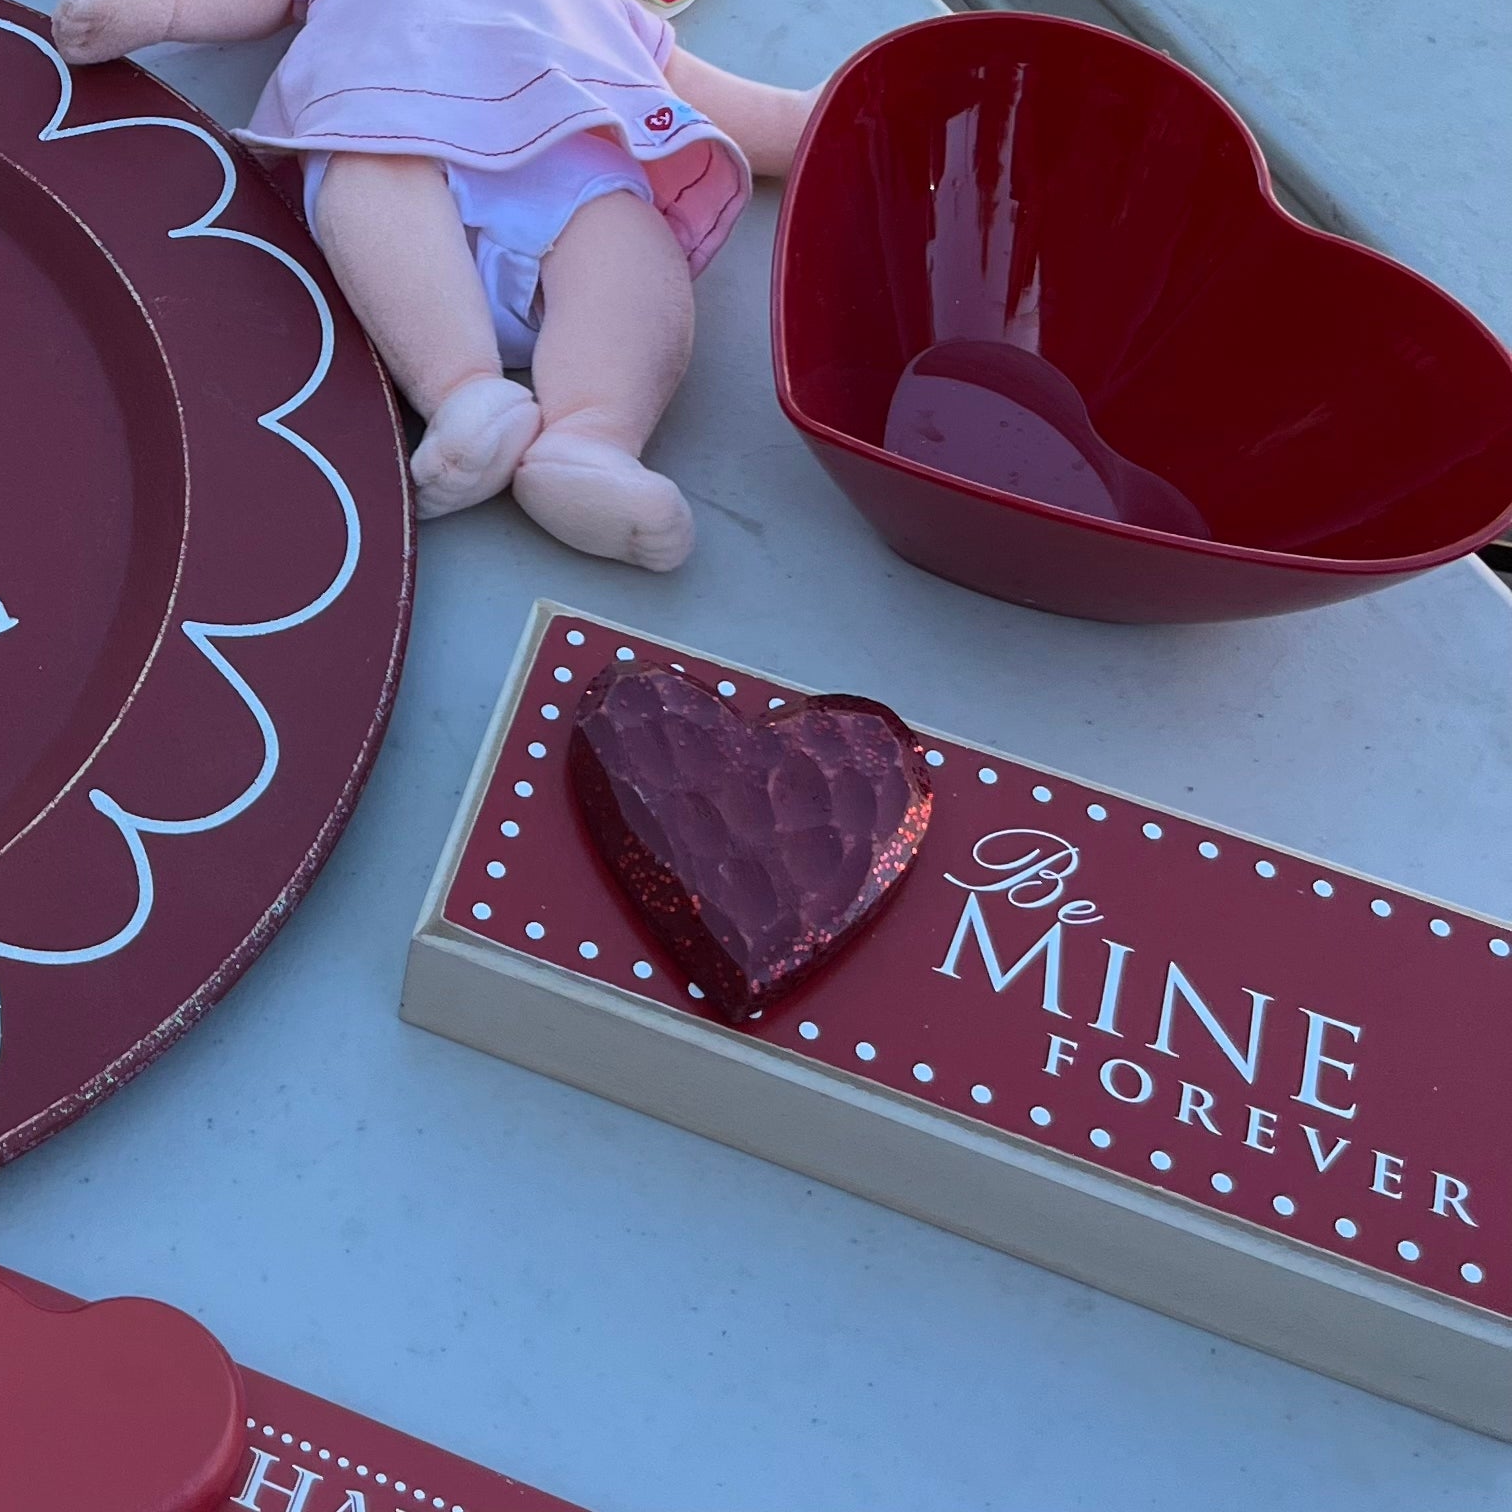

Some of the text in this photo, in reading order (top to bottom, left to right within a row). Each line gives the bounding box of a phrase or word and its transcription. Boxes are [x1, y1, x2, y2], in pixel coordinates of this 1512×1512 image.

[943, 828, 1105, 926] Be
[932, 890, 1362, 1120] MINE
[1041, 1032, 1480, 1229] FOREVER
